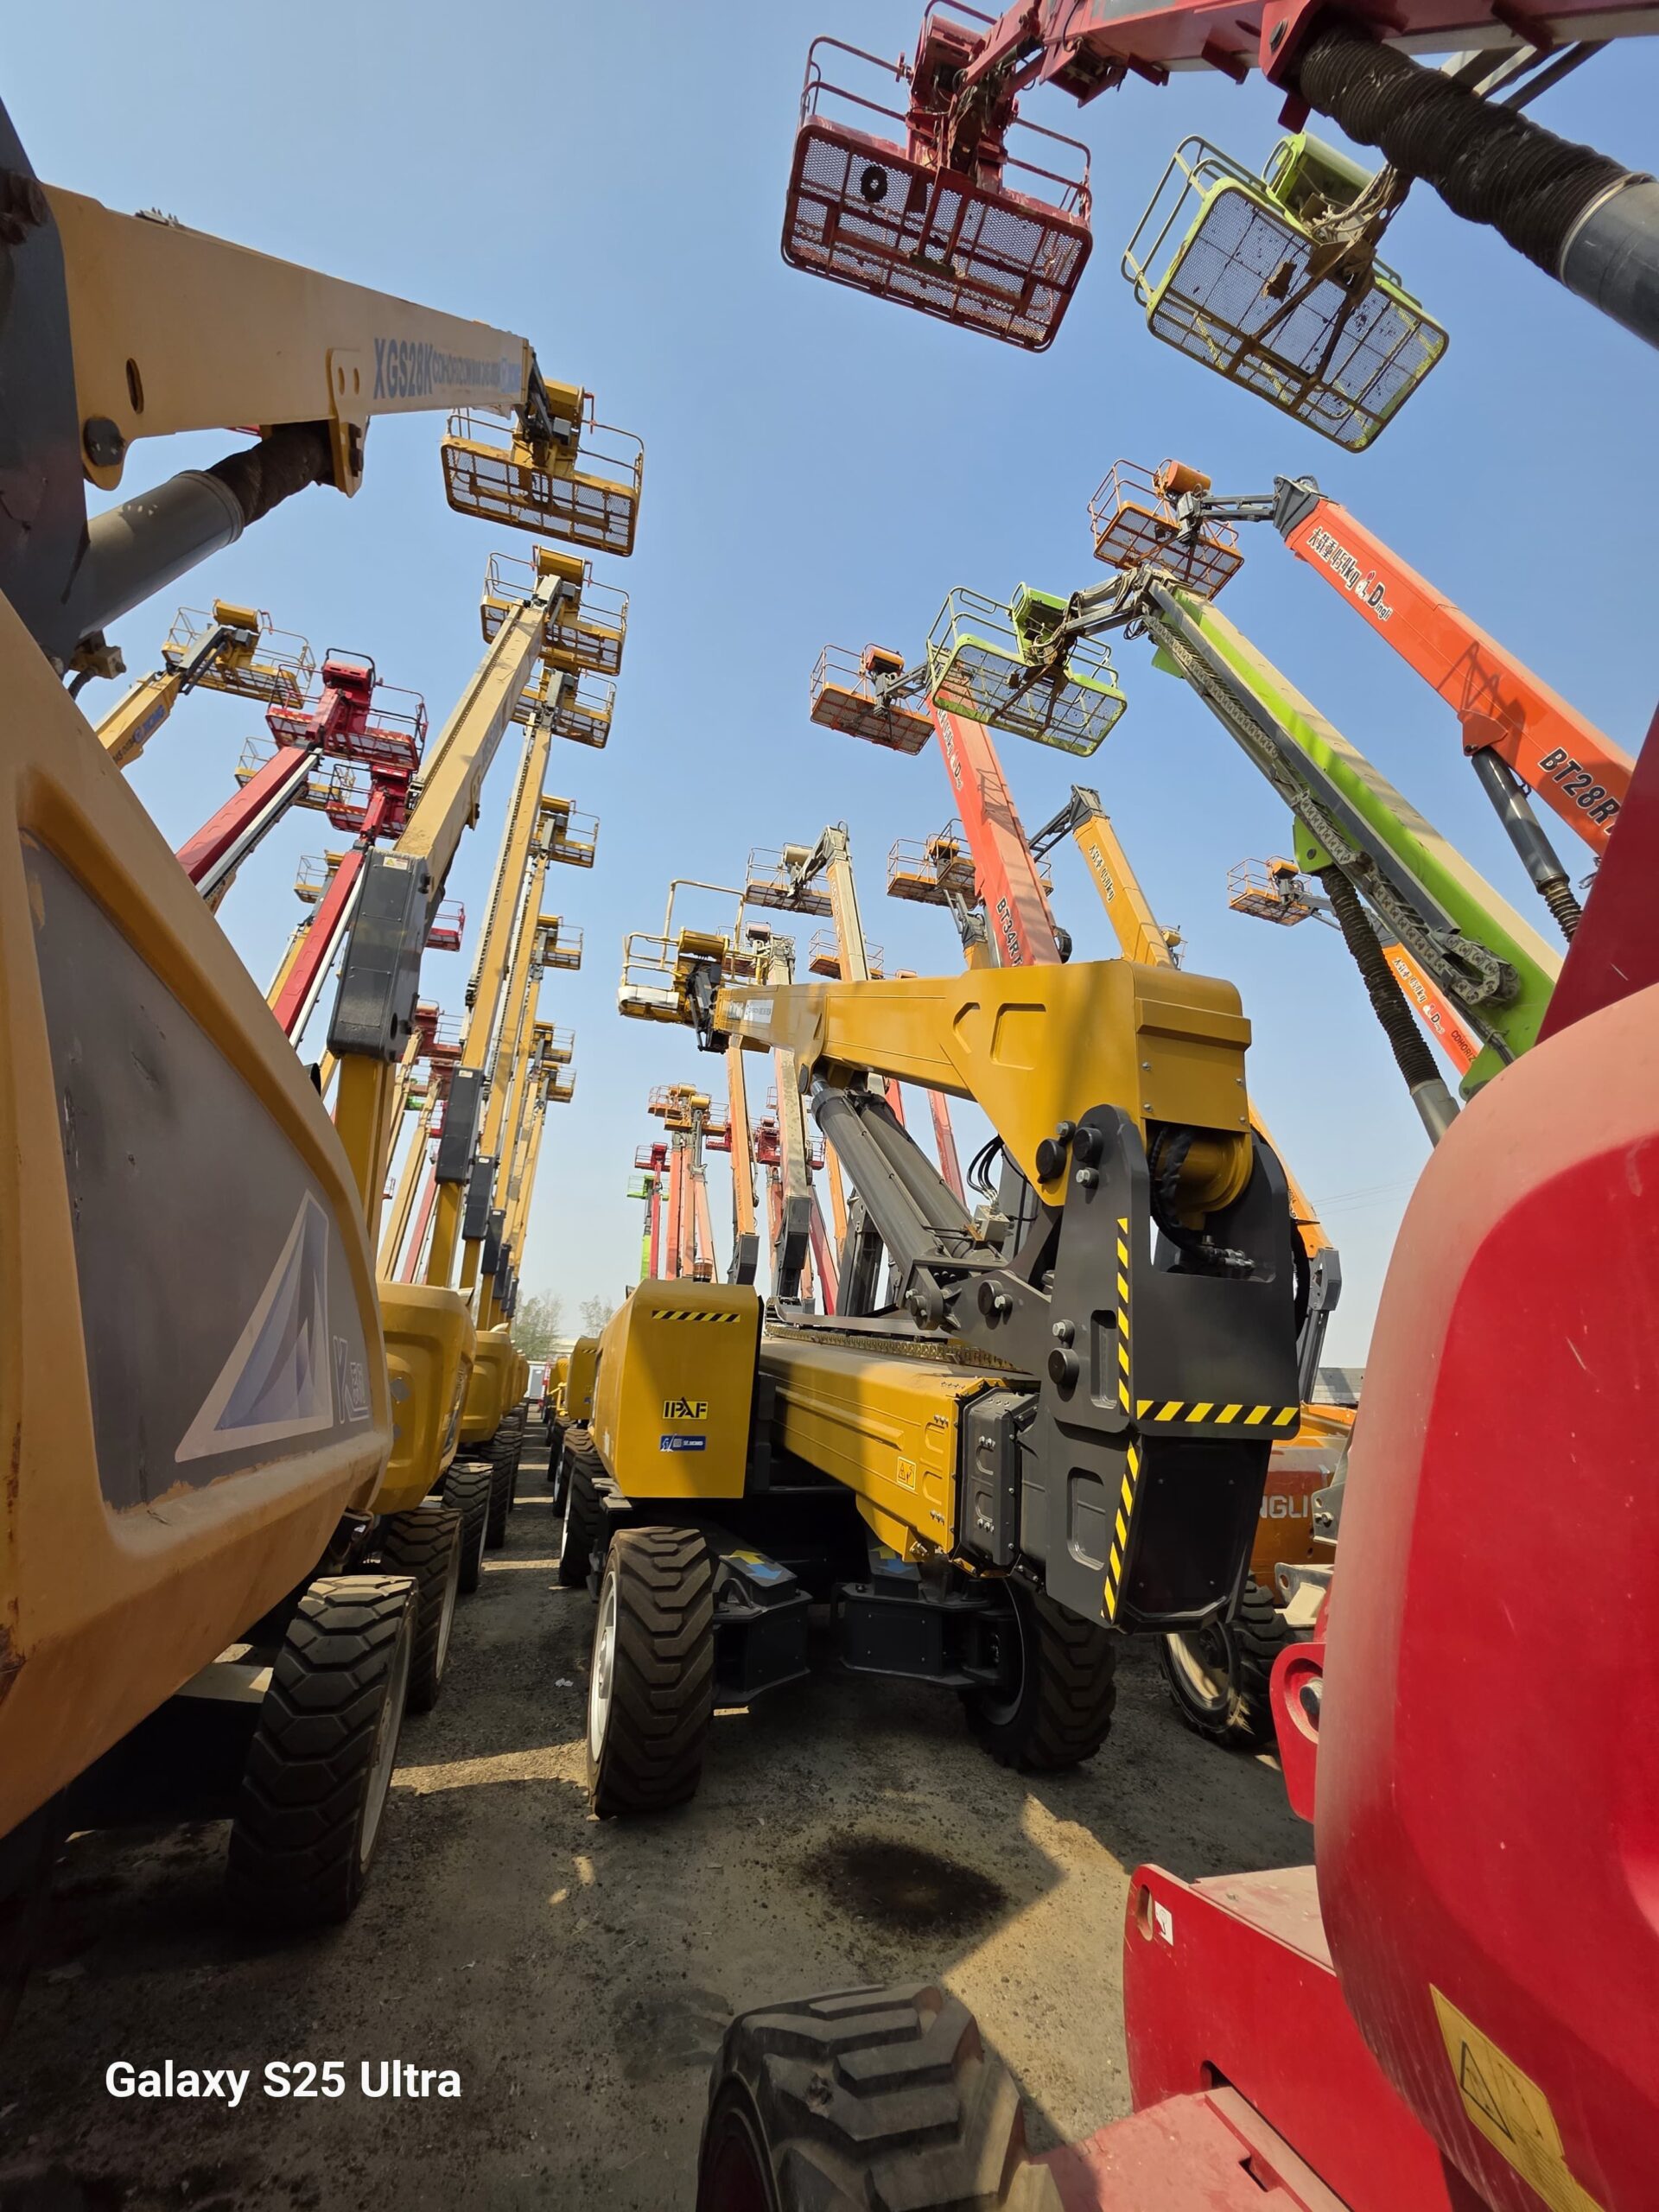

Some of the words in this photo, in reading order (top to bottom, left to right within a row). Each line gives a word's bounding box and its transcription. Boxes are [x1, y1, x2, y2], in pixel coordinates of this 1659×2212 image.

[373, 338, 433, 399] XGS28K
[1367, 582, 1393, 621] Dingli
[1538, 747, 1621, 836] BT28R
[996, 896, 1023, 966] BT34RT
[664, 1396, 707, 1418] IPAF
